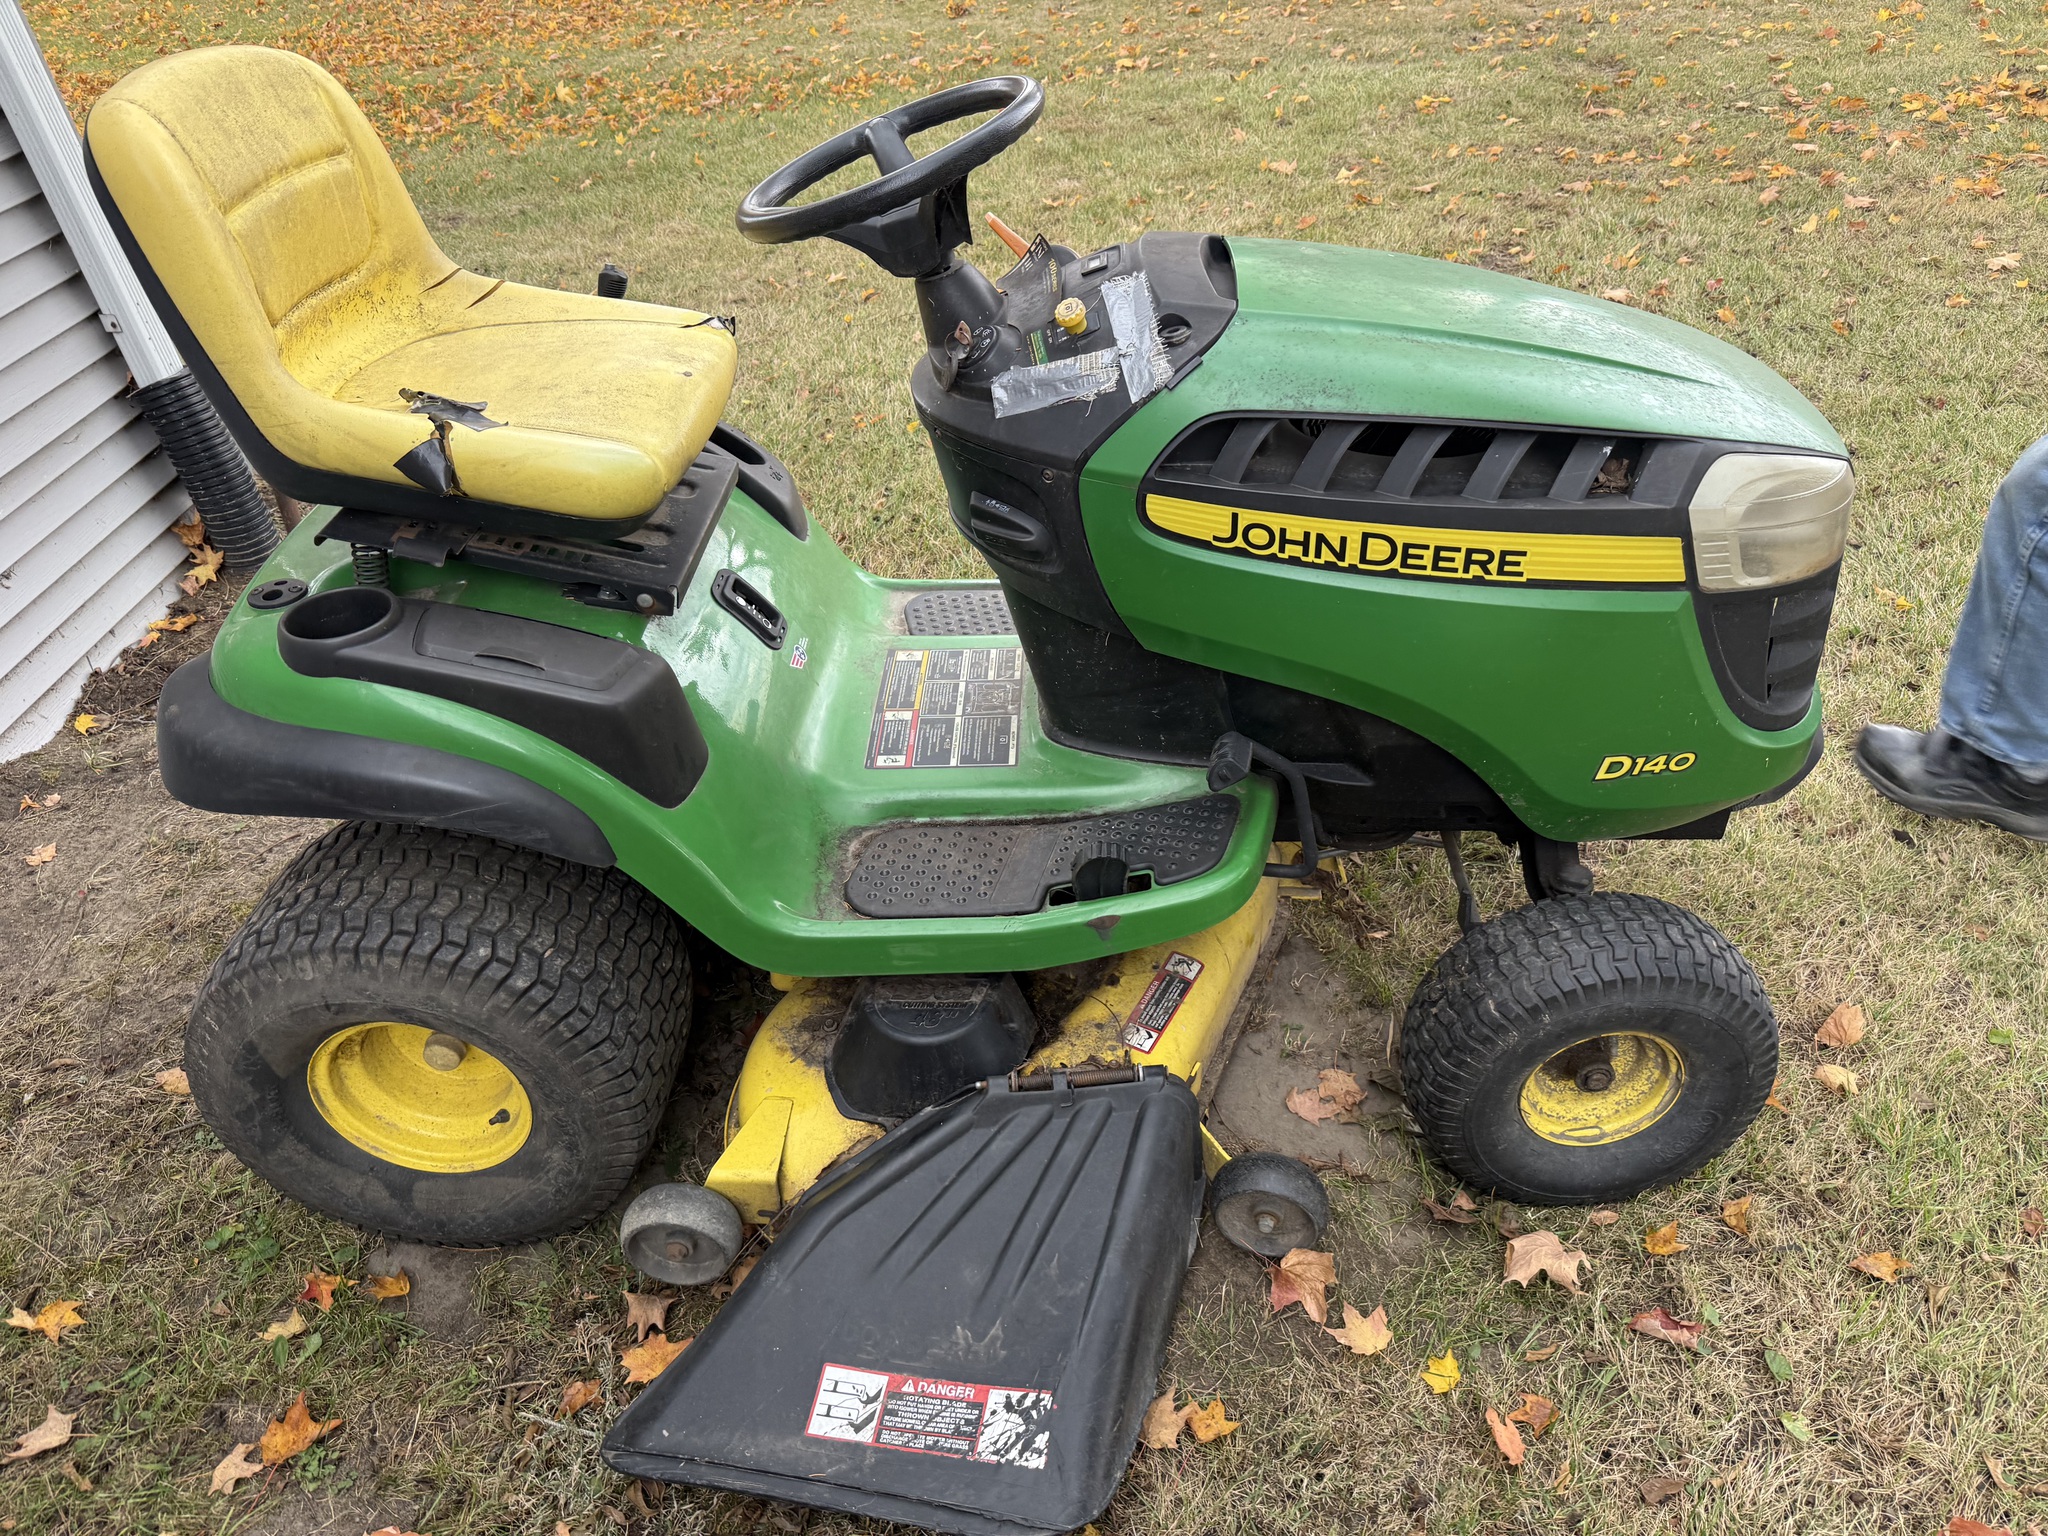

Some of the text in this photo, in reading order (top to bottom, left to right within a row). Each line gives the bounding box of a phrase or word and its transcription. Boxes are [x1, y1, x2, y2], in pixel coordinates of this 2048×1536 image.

[1212, 511, 1529, 579] JOHN DEERE
[1592, 751, 1698, 782] D140
[1142, 980, 1160, 1006] DANGER
[918, 1382, 975, 1399] DANGER
[898, 1411, 930, 1420] THROWN
